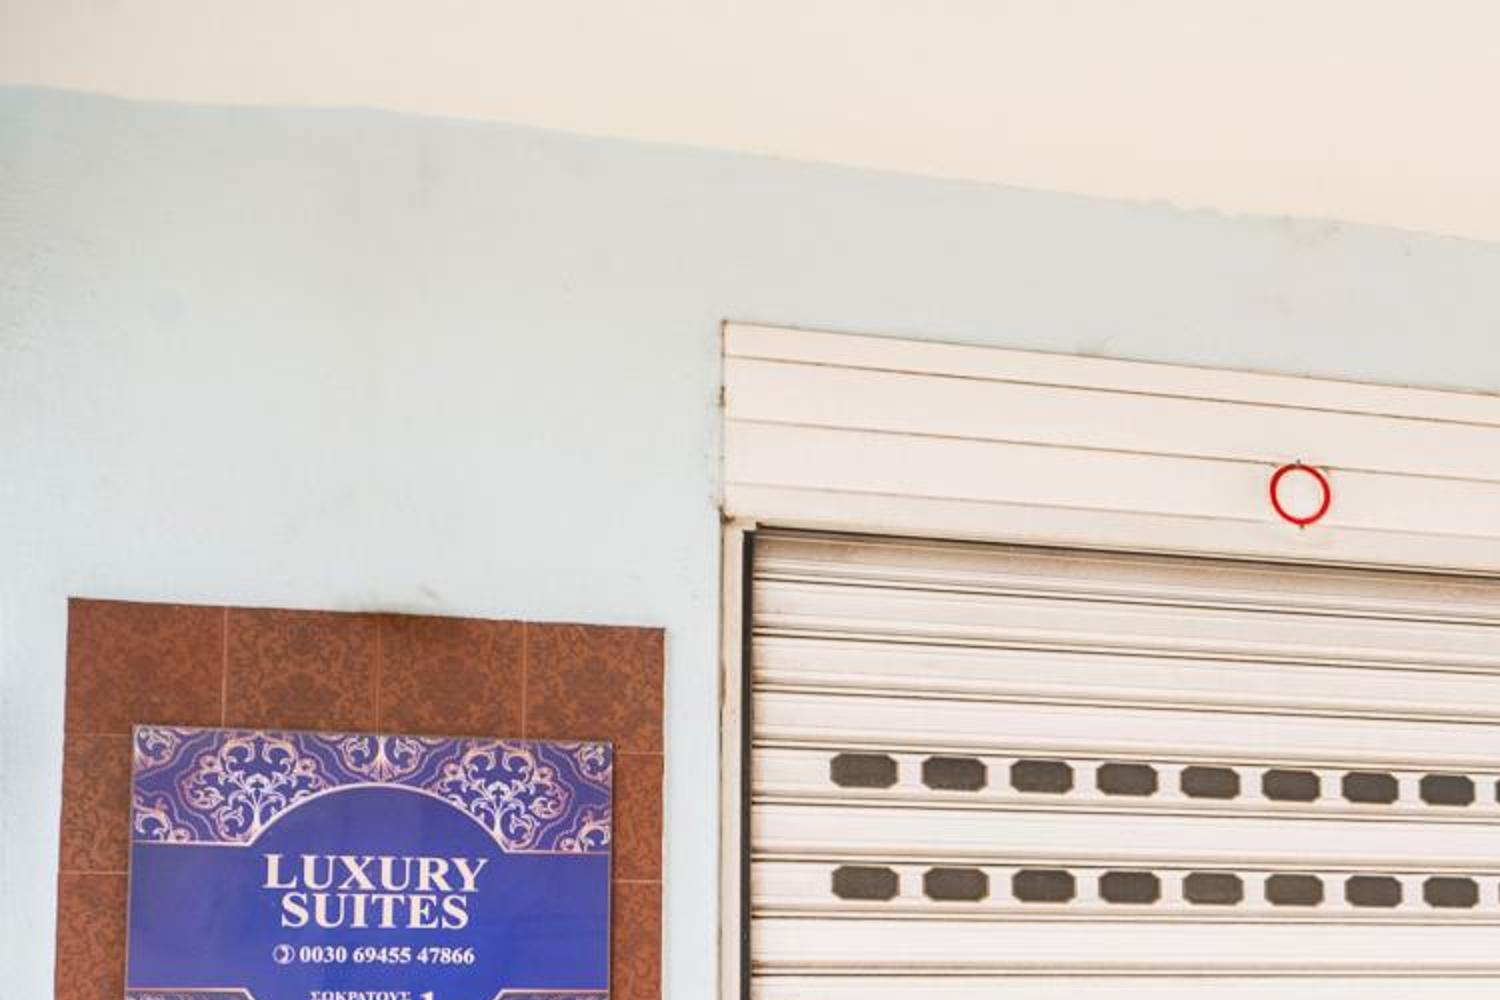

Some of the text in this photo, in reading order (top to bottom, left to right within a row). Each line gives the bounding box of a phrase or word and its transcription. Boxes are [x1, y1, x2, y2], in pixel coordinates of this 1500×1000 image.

[263, 853, 488, 893] LUXURY
[280, 892, 470, 930] SUITES
[299, 946, 475, 965] 0030 69455 47866
